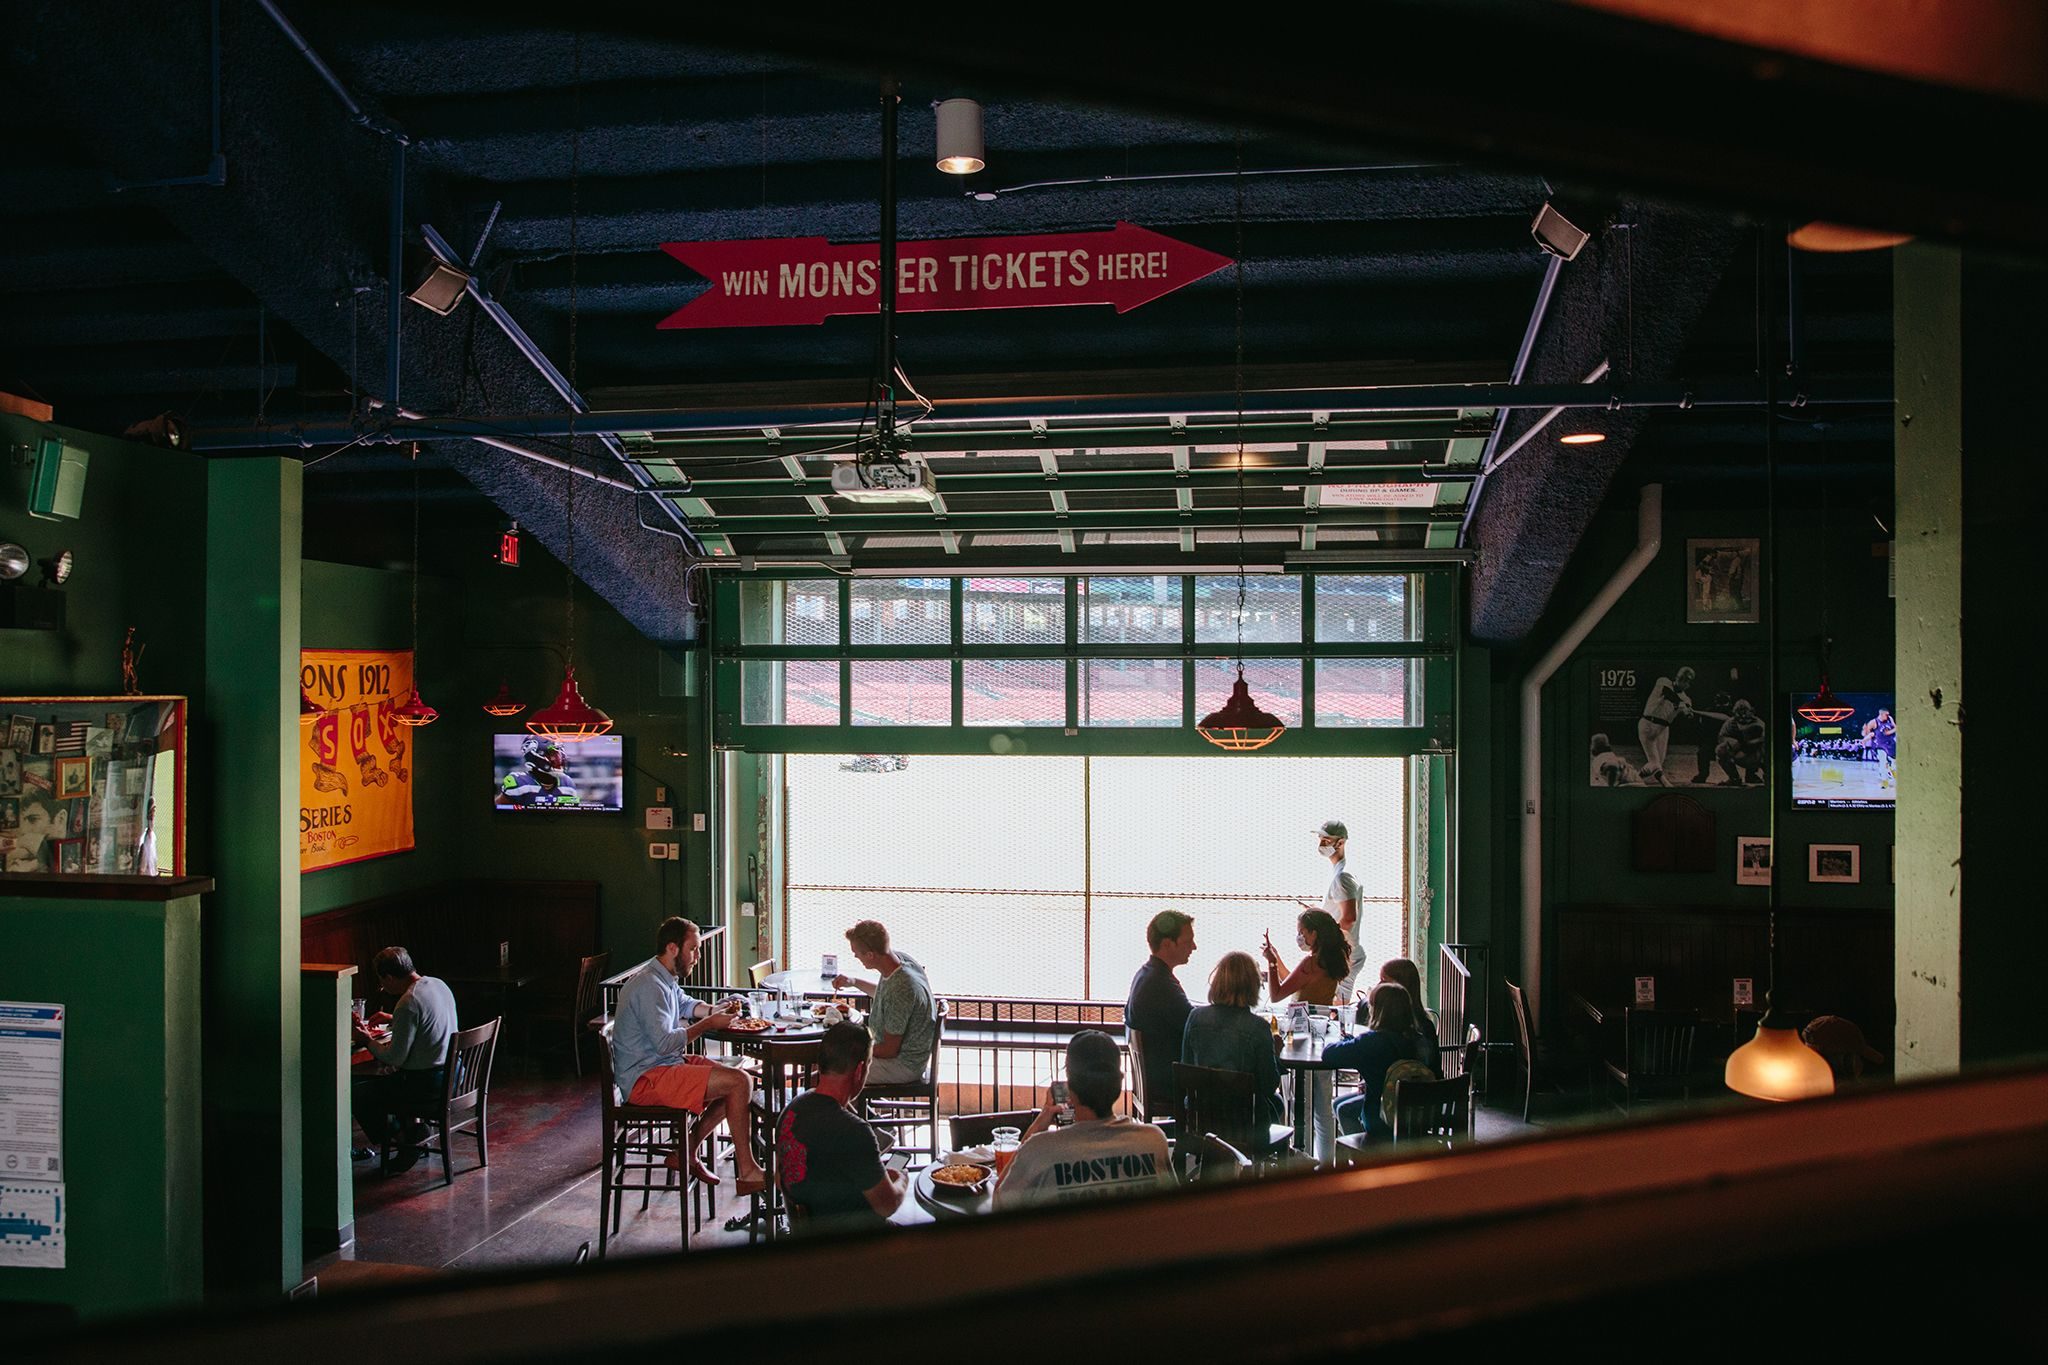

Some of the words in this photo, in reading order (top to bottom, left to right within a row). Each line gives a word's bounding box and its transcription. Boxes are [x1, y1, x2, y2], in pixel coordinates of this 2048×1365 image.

[722, 269, 769, 297] WIN
[778, 256, 938, 300] MONSER
[949, 248, 1090, 292] TICKETS
[1097, 251, 1168, 281] HERE!
[358, 664, 391, 695] 1912
[1600, 669, 1636, 688] 1975
[300, 804, 352, 833] SERIES
[307, 829, 337, 844] BOSTON
[1053, 1152, 1156, 1185] BOSTON
